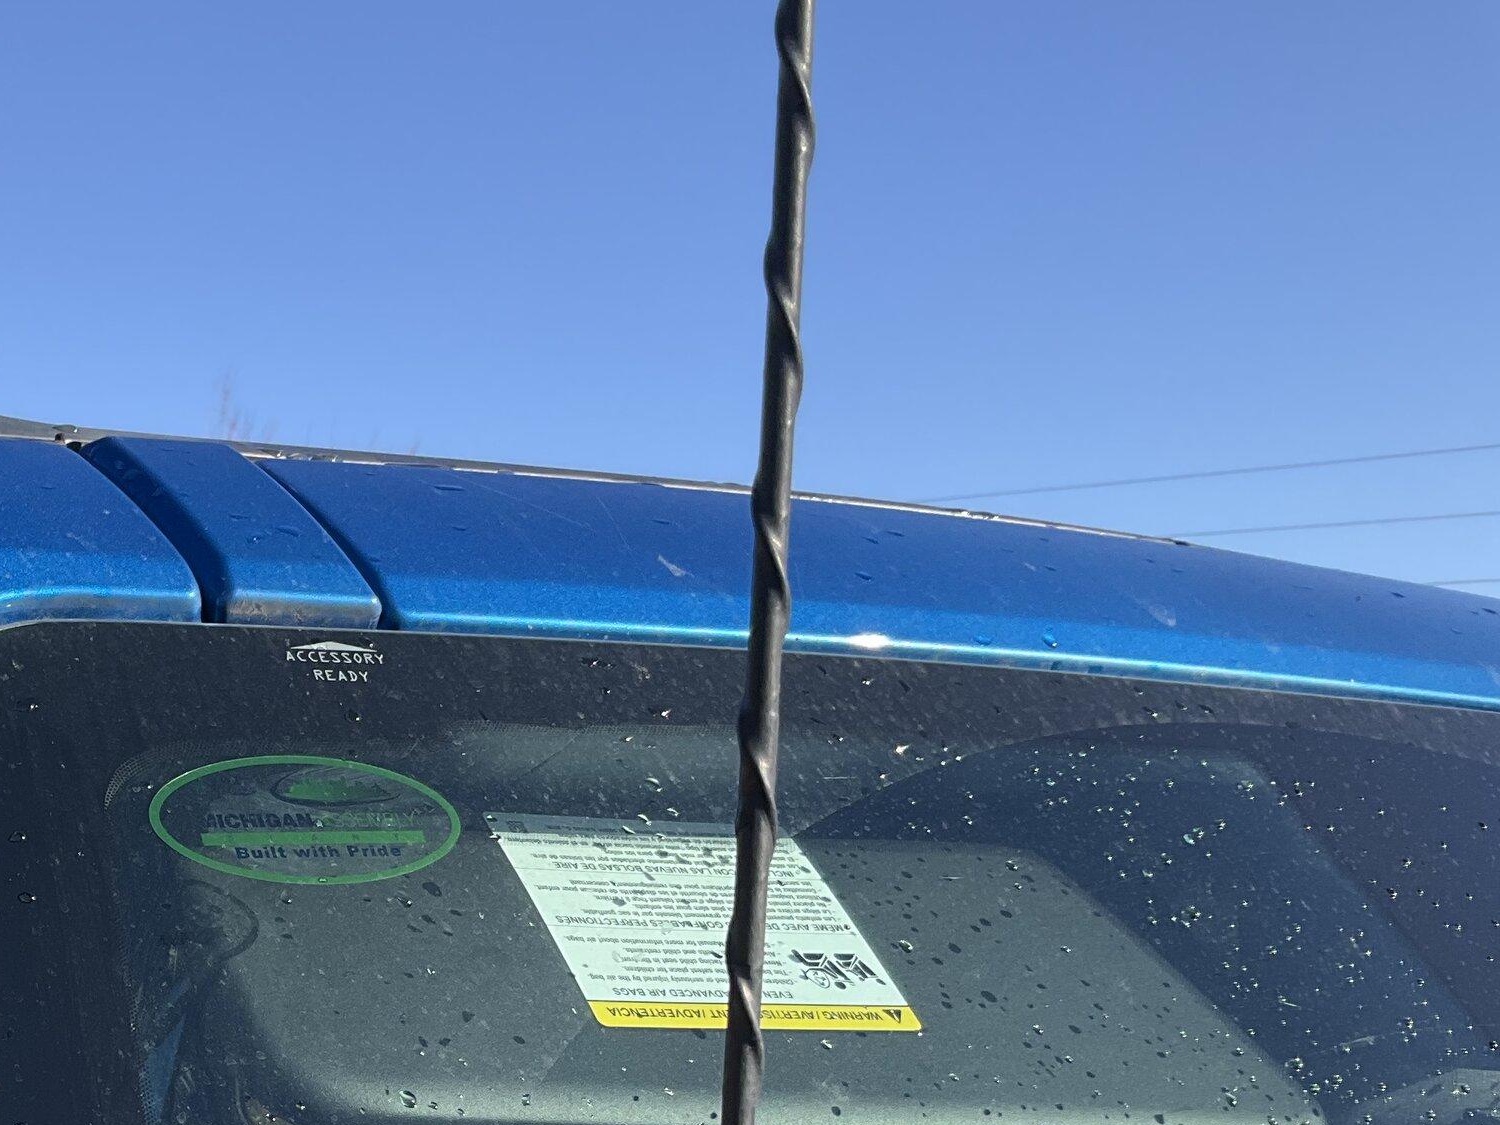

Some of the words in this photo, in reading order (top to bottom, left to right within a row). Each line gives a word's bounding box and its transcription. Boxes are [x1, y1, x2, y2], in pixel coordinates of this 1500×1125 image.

[285, 650, 384, 665] ACCESSORY
[313, 669, 368, 683] READY
[202, 813, 315, 829] MICHIGAN
[234, 846, 288, 860] Built
[295, 846, 340, 859] with
[346, 844, 402, 858] Pride
[580, 863, 598, 871] DE
[597, 864, 645, 873] BOLSAS
[644, 866, 690, 875] NUEVAS
[611, 988, 647, 996] BAGS
[646, 989, 669, 997] AIR
[821, 1012, 884, 1021] WARNING
